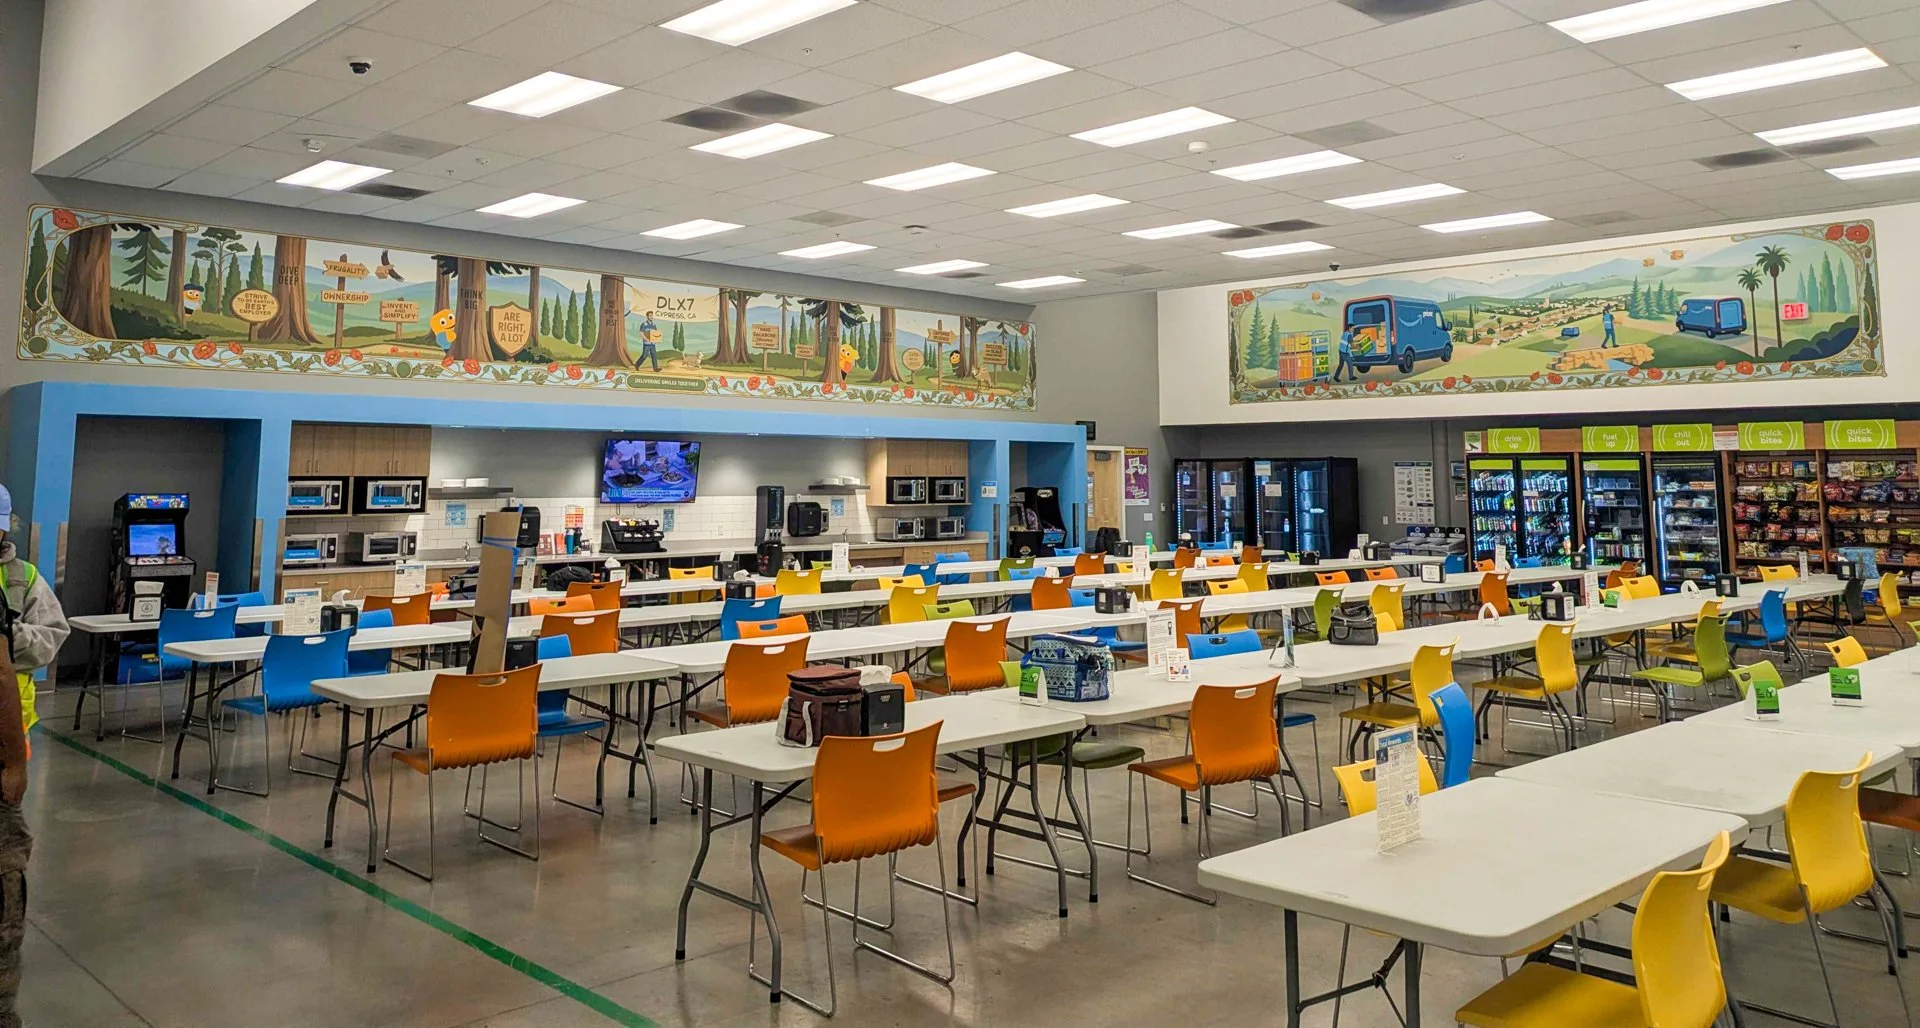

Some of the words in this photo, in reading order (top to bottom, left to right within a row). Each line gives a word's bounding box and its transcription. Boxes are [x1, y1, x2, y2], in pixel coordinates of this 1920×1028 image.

[280, 265, 299, 276] DIVE
[329, 264, 366, 275] FRUGALITY
[278, 275, 299, 286] DEEP
[323, 292, 369, 302] OWNERSHIP
[460, 288, 483, 300] THINK
[464, 300, 478, 310] BIG
[656, 296, 695, 311] DLX7
[240, 308, 272, 316] EMPLOYER
[655, 310, 686, 320] CYPRESS,
[687, 312, 697, 320] CA
[1785, 304, 1804, 318] EXIT
[504, 312, 520, 322] ARE
[498, 322, 526, 334] RIGHT,
[500, 332, 506, 342] A
[508, 333, 524, 343] LOT
[1759, 428, 1784, 438] quick
[1846, 427, 1872, 436] quick
[1760, 436, 1783, 444] bites
[1848, 435, 1872, 443] bites
